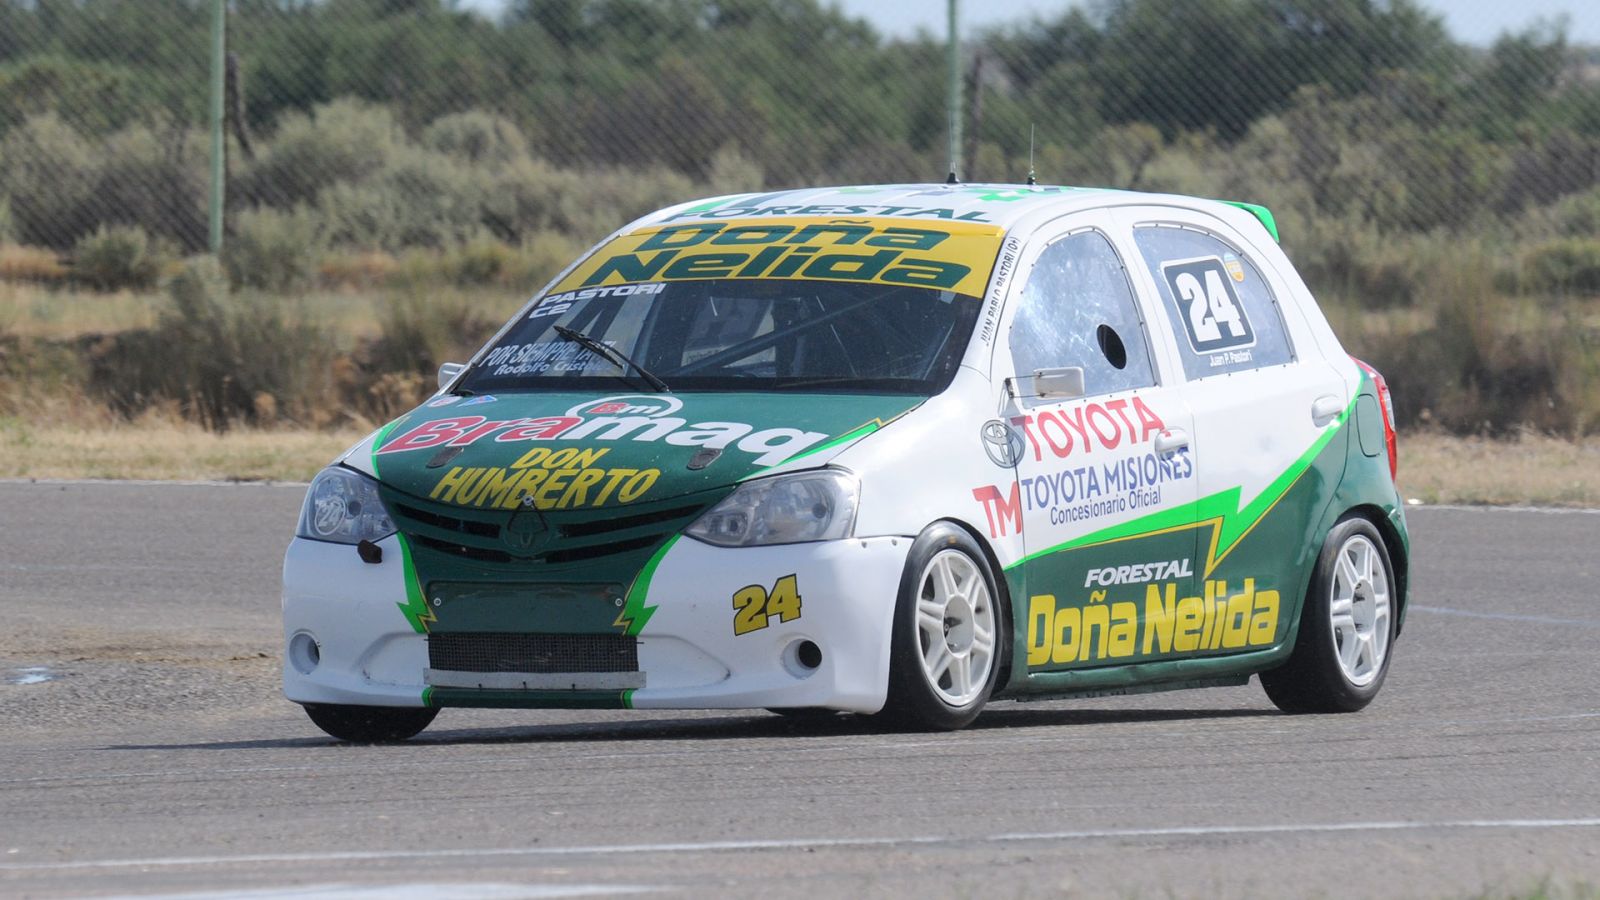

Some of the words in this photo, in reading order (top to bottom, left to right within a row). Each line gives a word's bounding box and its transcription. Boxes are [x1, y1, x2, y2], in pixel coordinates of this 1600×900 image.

[633, 219, 951, 252] Doña
[657, 205, 993, 224] FORESTAL
[580, 246, 971, 289] Nelida
[996, 252, 1015, 288] PASTORI
[529, 303, 572, 319] C2
[538, 283, 667, 307] PASTORI
[1175, 269, 1247, 342] 24
[376, 415, 829, 467] Bramaq
[1010, 396, 1171, 462] TOYOTA
[509, 447, 609, 469] DON
[430, 466, 661, 510] HUMBERTO
[1021, 466, 1101, 511] TOYOTA
[1104, 449, 1192, 495] MISIONES
[972, 481, 1022, 539] TM
[1050, 496, 1126, 526] Concesionario
[1128, 487, 1161, 510] Oficial
[1084, 559, 1193, 588] FORESTAL
[732, 573, 802, 636] 24
[1027, 590, 1138, 666] Doña
[1142, 578, 1280, 655] Nelida
